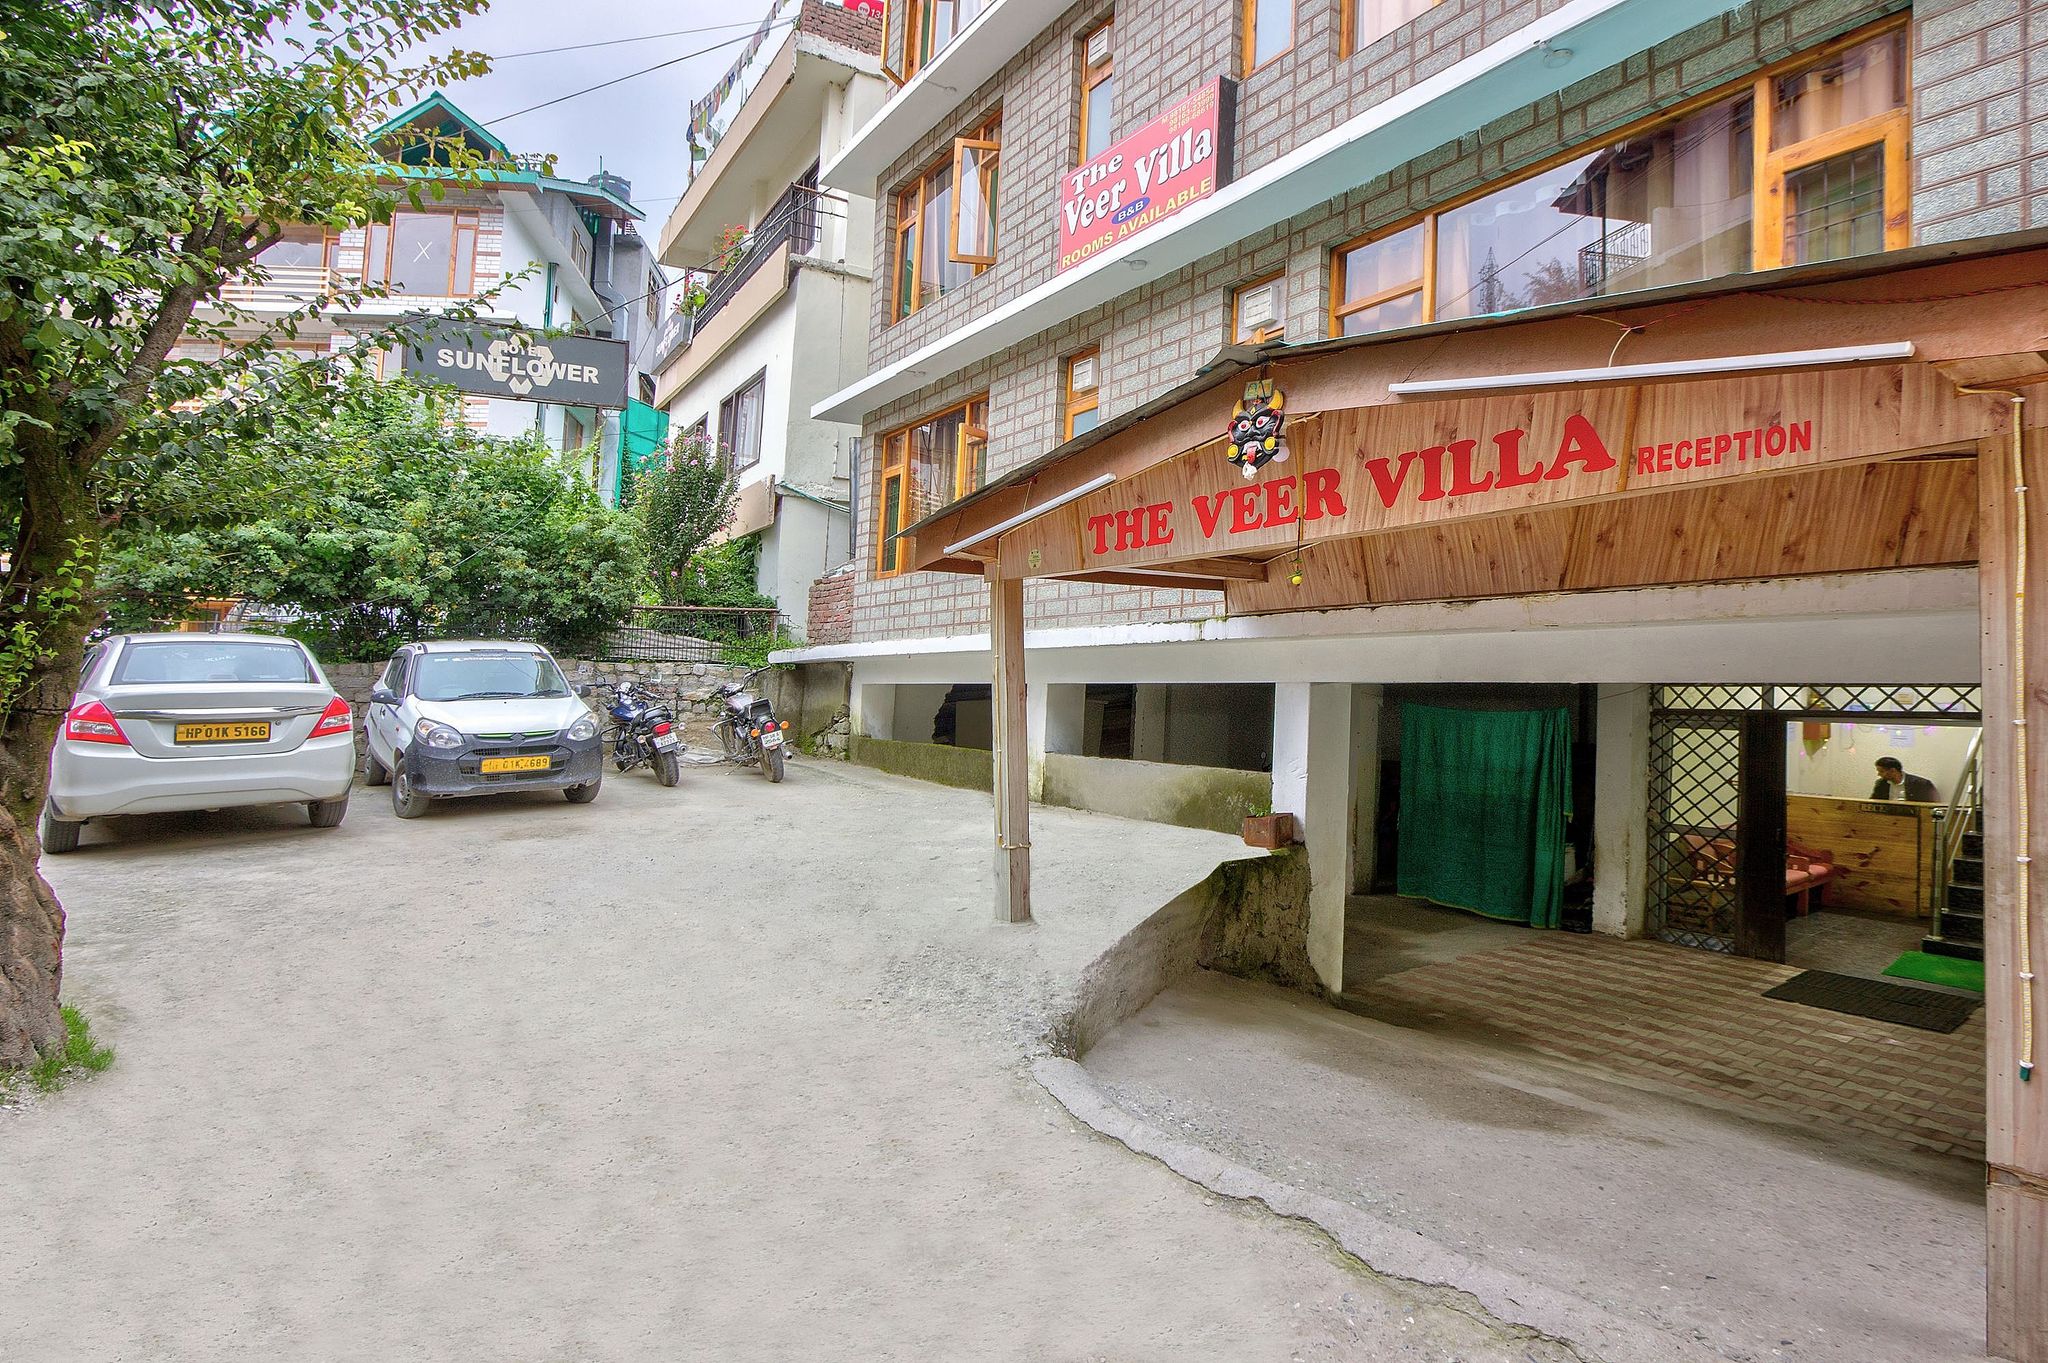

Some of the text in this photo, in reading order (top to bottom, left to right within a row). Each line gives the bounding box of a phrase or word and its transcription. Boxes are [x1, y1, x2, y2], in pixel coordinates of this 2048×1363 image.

[1064, 128, 1213, 235] Veer Villa
[1071, 153, 1124, 196] The
[1062, 177, 1212, 268] ROOMS AVAILABLE
[1118, 200, 1145, 221] B&B
[437, 348, 599, 384] SUNFLOWER
[499, 342, 545, 358] HOTEL
[1088, 414, 1812, 555] THE VEER VILLA RECEPTION
[185, 727, 202, 739] HP
[234, 725, 267, 737] 5166
